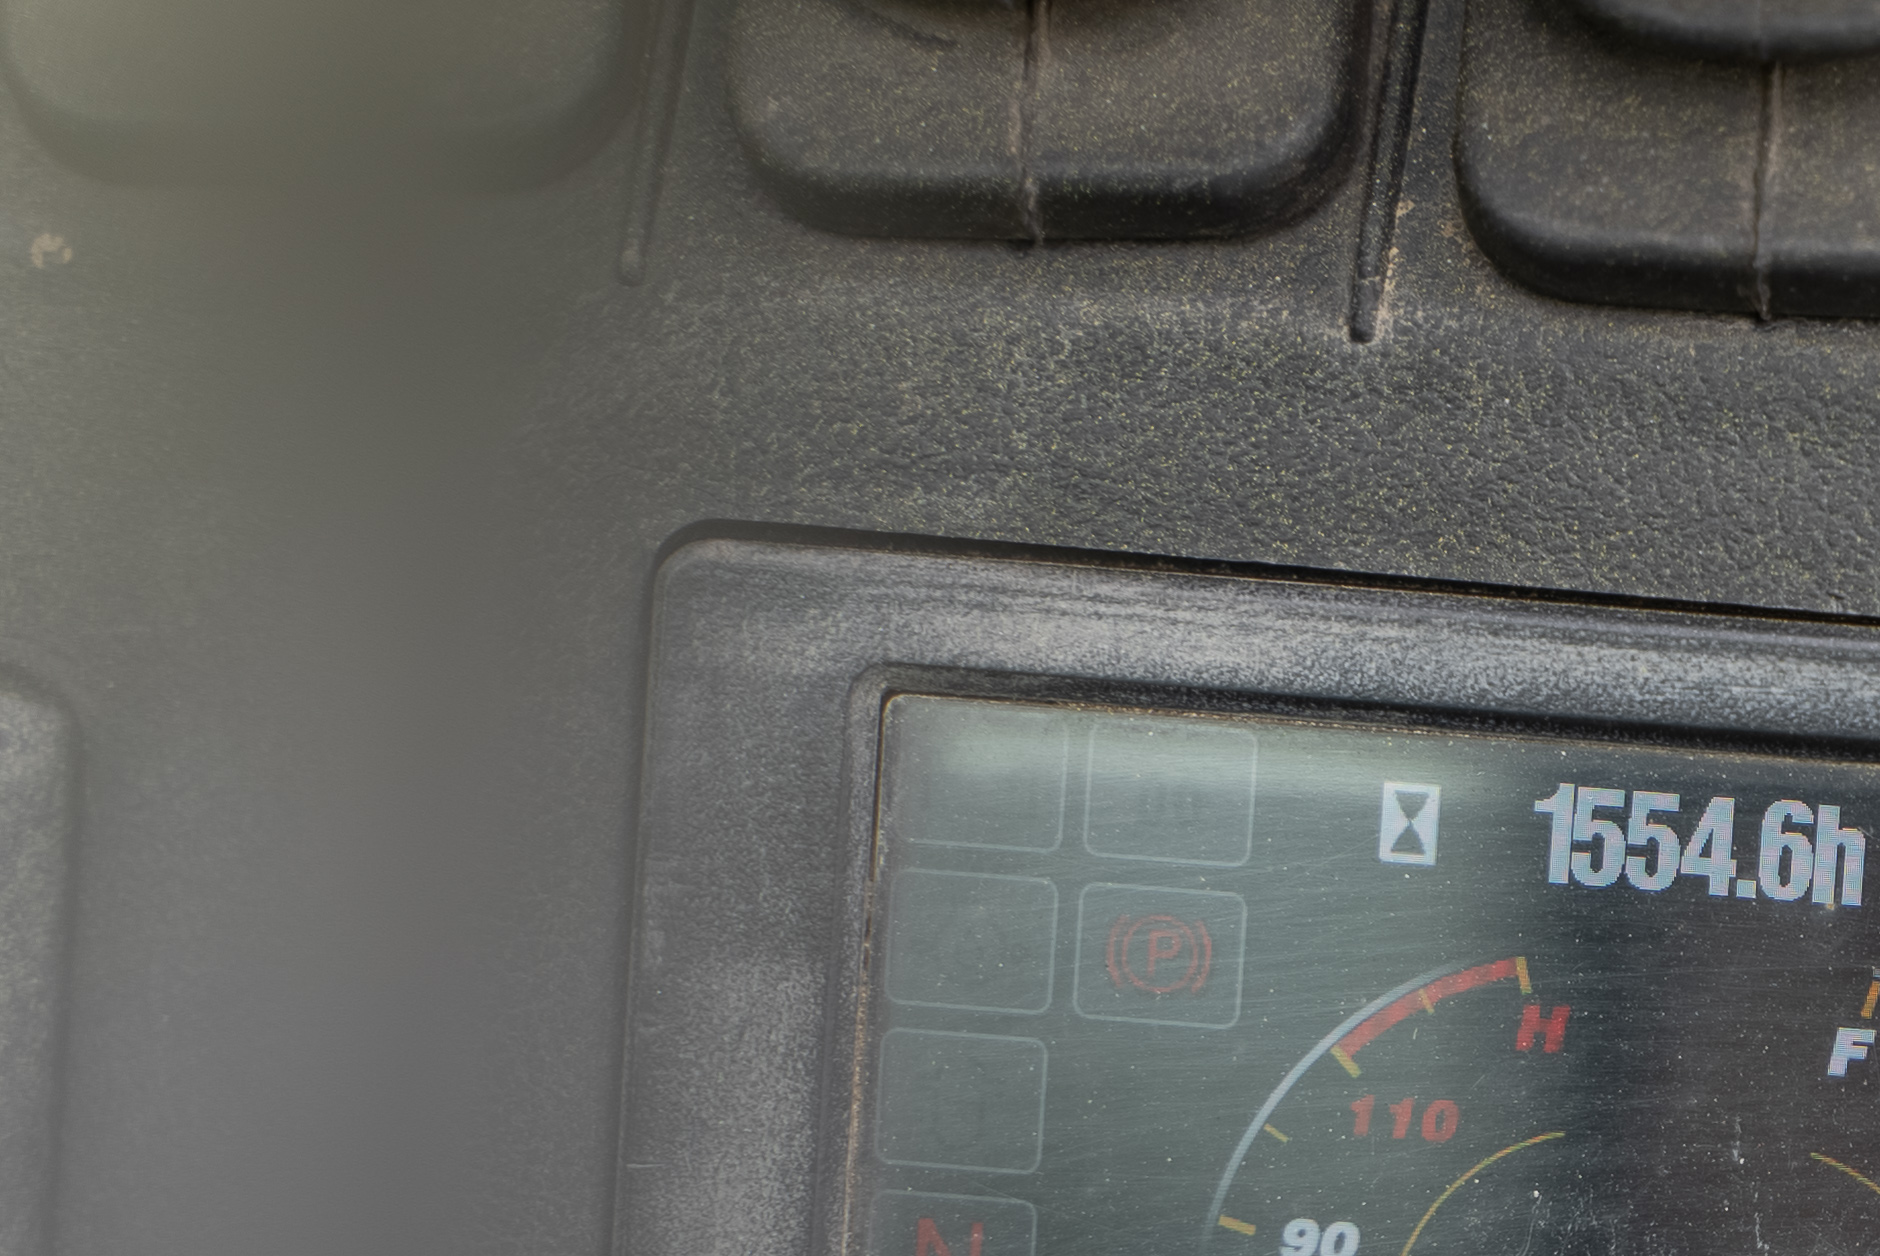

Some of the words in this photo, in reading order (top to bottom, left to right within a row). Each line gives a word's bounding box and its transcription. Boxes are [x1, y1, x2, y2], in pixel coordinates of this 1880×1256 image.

[1534, 783, 1866, 906] 1554.6h
[1147, 928, 1182, 978] P
[1515, 1004, 1571, 1054] H
[1827, 1026, 1877, 1078] F
[1350, 1095, 1460, 1143] 110
